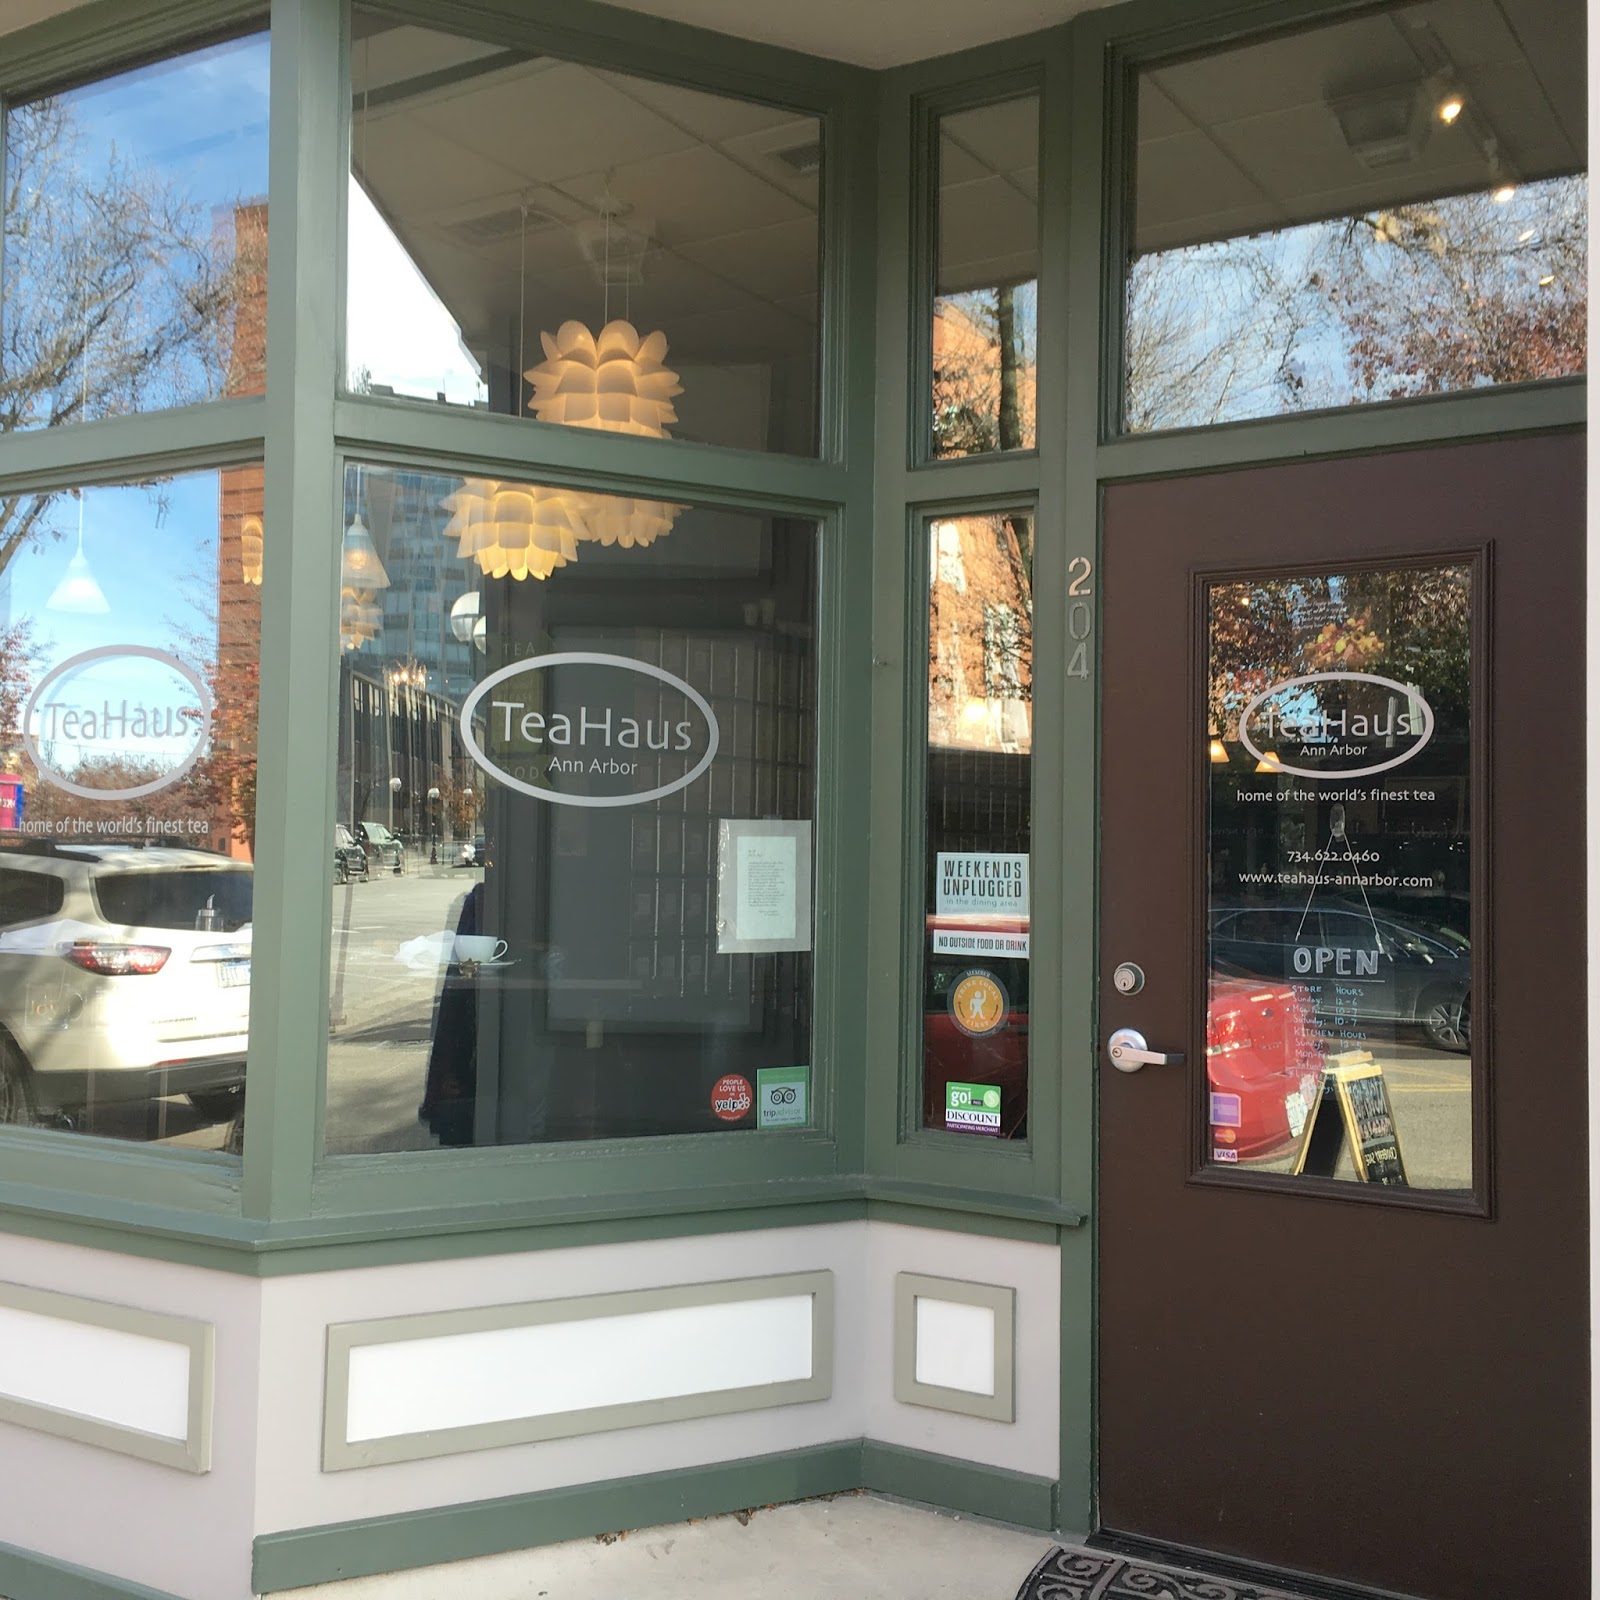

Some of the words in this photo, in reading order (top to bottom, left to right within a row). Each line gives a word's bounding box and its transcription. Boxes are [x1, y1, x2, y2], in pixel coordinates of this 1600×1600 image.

[1067, 556, 1092, 680] 204
[503, 641, 536, 656] TEA
[44, 699, 189, 741] TeaHaus
[492, 701, 692, 751] TeaHaus
[1259, 709, 1411, 739] TeaHaus
[1300, 745, 1326, 757] Ann
[1330, 744, 1368, 756] Arbor
[549, 756, 584, 773] Ann
[589, 758, 638, 775] Arbor
[1236, 789, 1273, 801] home
[1276, 789, 1290, 801] of
[1293, 789, 1315, 801] the
[1319, 789, 1367, 801] world's
[1370, 788, 1410, 801] finest
[1413, 790, 1435, 801] tea
[19, 817, 52, 833] home
[56, 816, 70, 833] of
[73, 817, 93, 833] the
[97, 816, 142, 833] world's
[146, 816, 183, 833] finest
[187, 818, 209, 833] tea
[1287, 850, 1380, 863] 734.622.0460
[944, 860, 1021, 879] WEEKENDS
[1239, 871, 1433, 887] www.teahaus-annarbor.com
[943, 879, 1022, 897] UNPLUGGED
[971, 898, 997, 907] dining
[938, 936, 948, 947] NO
[949, 937, 976, 949] OUTSIDE
[977, 938, 994, 950] FOOD
[995, 939, 1005, 950] OR
[1005, 940, 1027, 951] DRINK
[1293, 947, 1379, 975] OPEN
[966, 969, 991, 978] MEMBER
[957, 979, 977, 999] THINK
[979, 980, 999, 1001] LOCAL
[1292, 985, 1322, 993] STORE
[1336, 986, 1364, 996] HOURS
[966, 1019, 989, 1028] FIRST
[1294, 1026, 1335, 1037] KITCHEN
[1340, 1029, 1367, 1039] HOURS
[716, 1098, 739, 1112] yelp
[951, 1091, 972, 1107] go!
[947, 1110, 999, 1124] DISCOUNT
[946, 1122, 976, 1131] PARTICIPATING
[976, 1124, 998, 1133] MERCHANT
[1216, 1151, 1236, 1159] VISA
